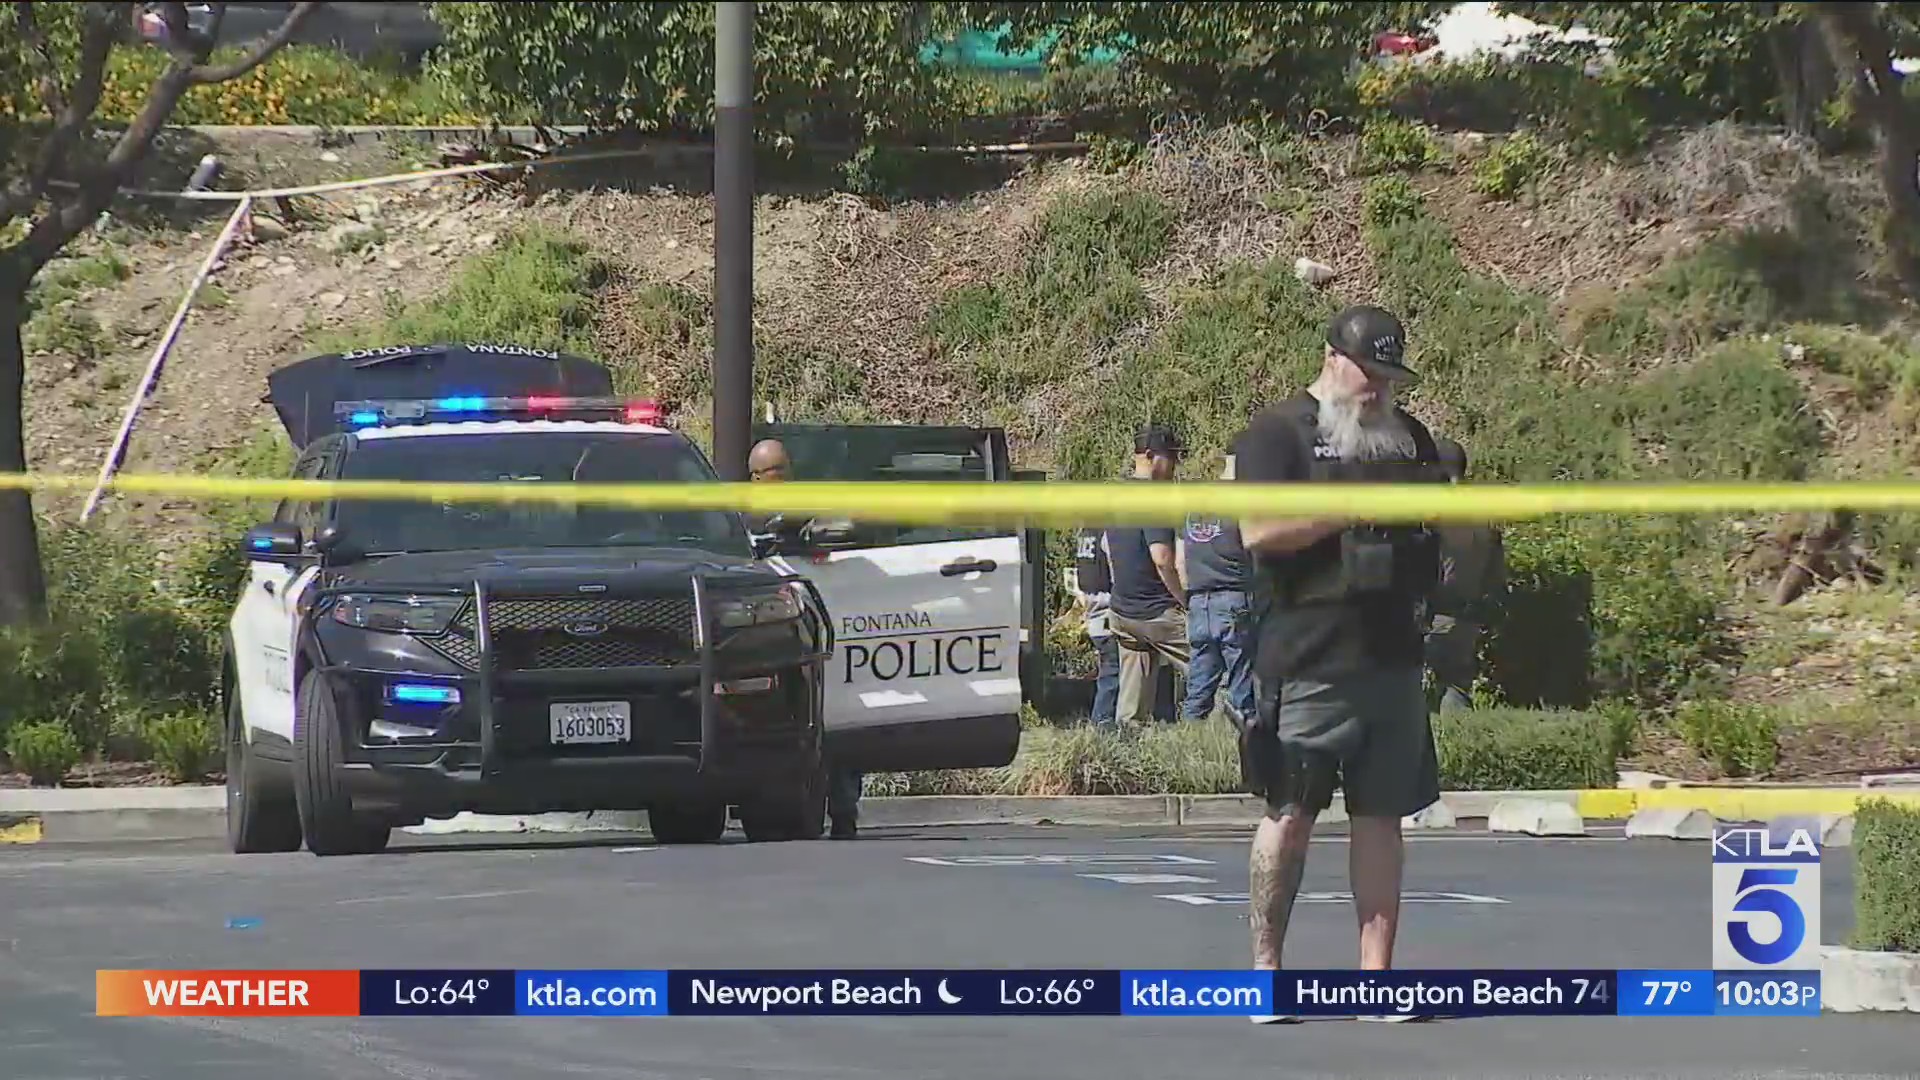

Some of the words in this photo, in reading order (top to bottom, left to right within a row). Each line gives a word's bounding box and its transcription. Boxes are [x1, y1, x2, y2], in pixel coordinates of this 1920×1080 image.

[465, 343, 559, 360] FONTANA
[841, 611, 931, 634] FONTANA
[843, 634, 1003, 684] POLICE
[556, 717, 625, 738] 1603053
